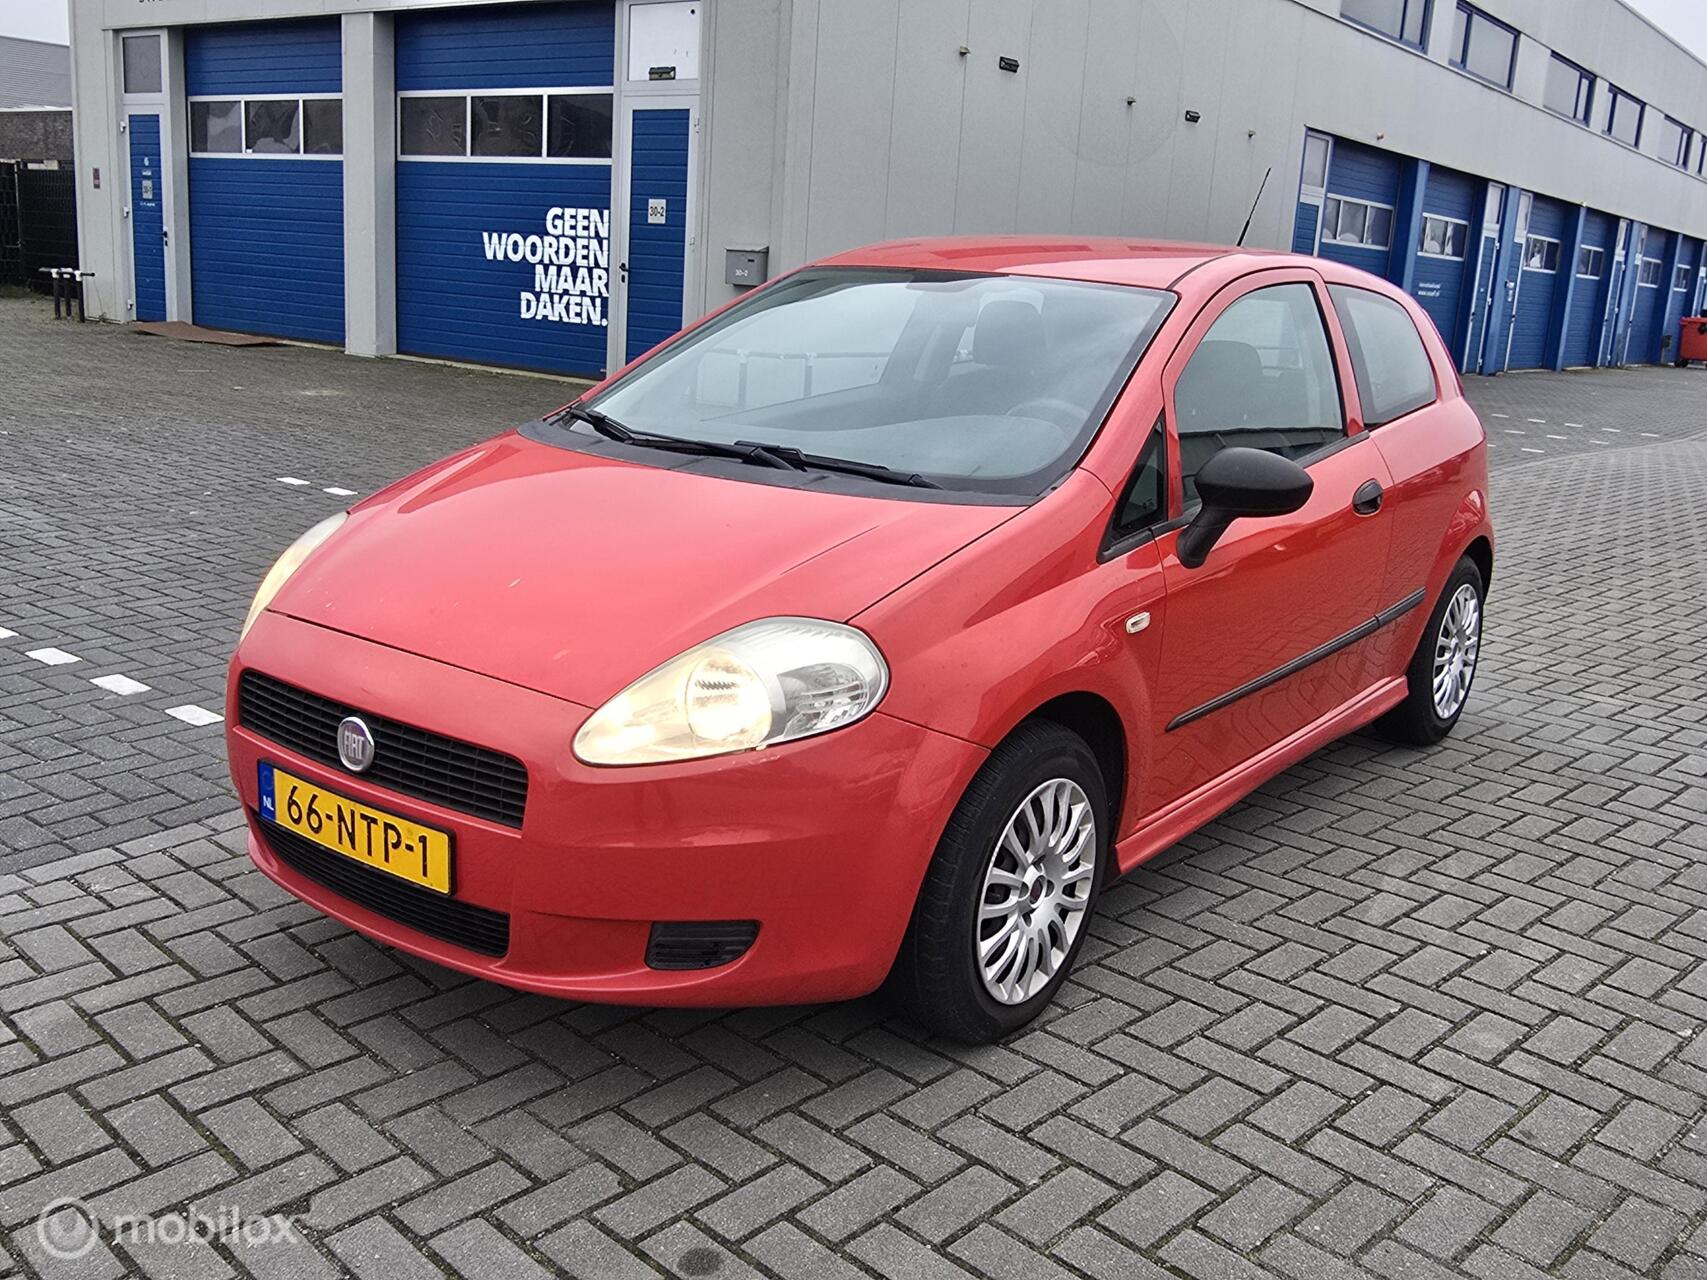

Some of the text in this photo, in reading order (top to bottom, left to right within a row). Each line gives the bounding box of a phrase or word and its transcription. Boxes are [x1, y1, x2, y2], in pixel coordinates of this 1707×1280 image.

[545, 206, 610, 239] GEEN
[649, 205, 665, 217] 30-2
[482, 231, 609, 268] WOORDEN
[534, 264, 610, 298] MAAR
[520, 291, 609, 328] DAKEN.
[343, 729, 366, 761] FIAT
[262, 795, 275, 812] NL
[286, 784, 429, 879] 66-NTP-1
